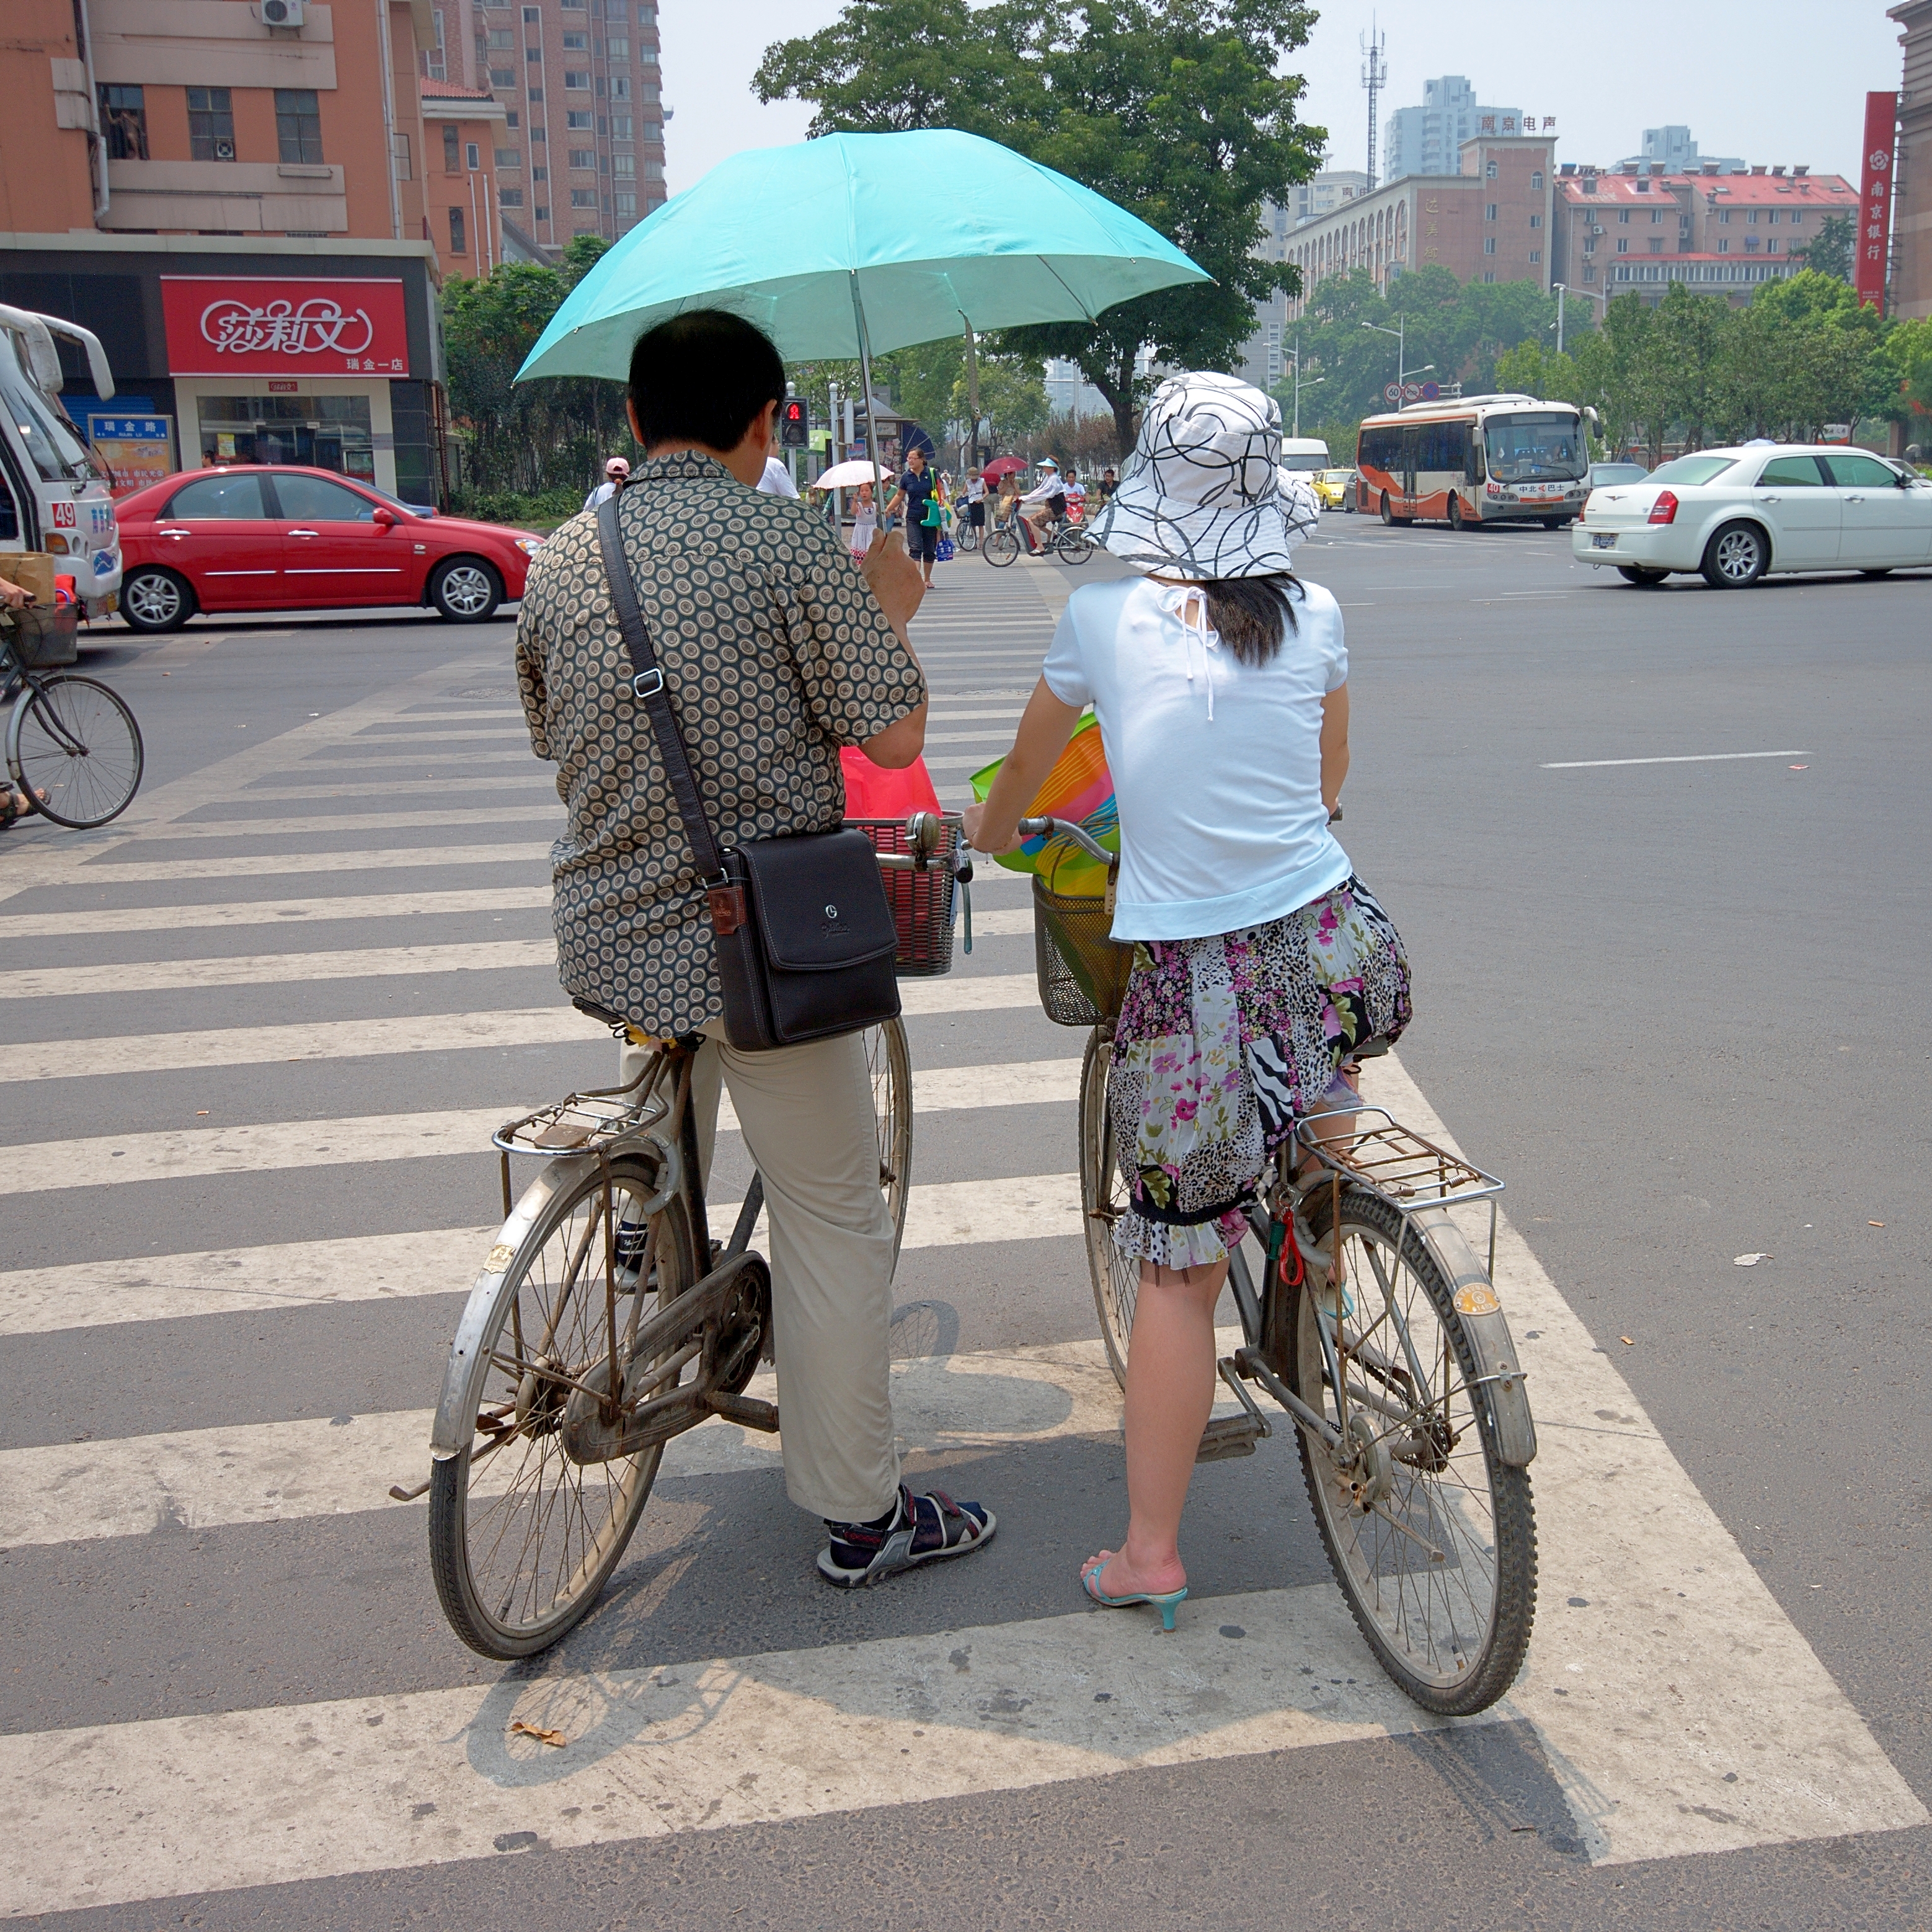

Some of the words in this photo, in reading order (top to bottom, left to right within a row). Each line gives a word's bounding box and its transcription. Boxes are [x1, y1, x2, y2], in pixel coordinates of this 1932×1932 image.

[1481, 116, 1556, 130] 南京电声
[1866, 181, 1884, 260] 南京银行
[347, 358, 403, 370] 瑞金一店
[1389, 388, 1399, 396] 60
[104, 421, 156, 432] 瑞金路
[56, 503, 74, 526] 49
